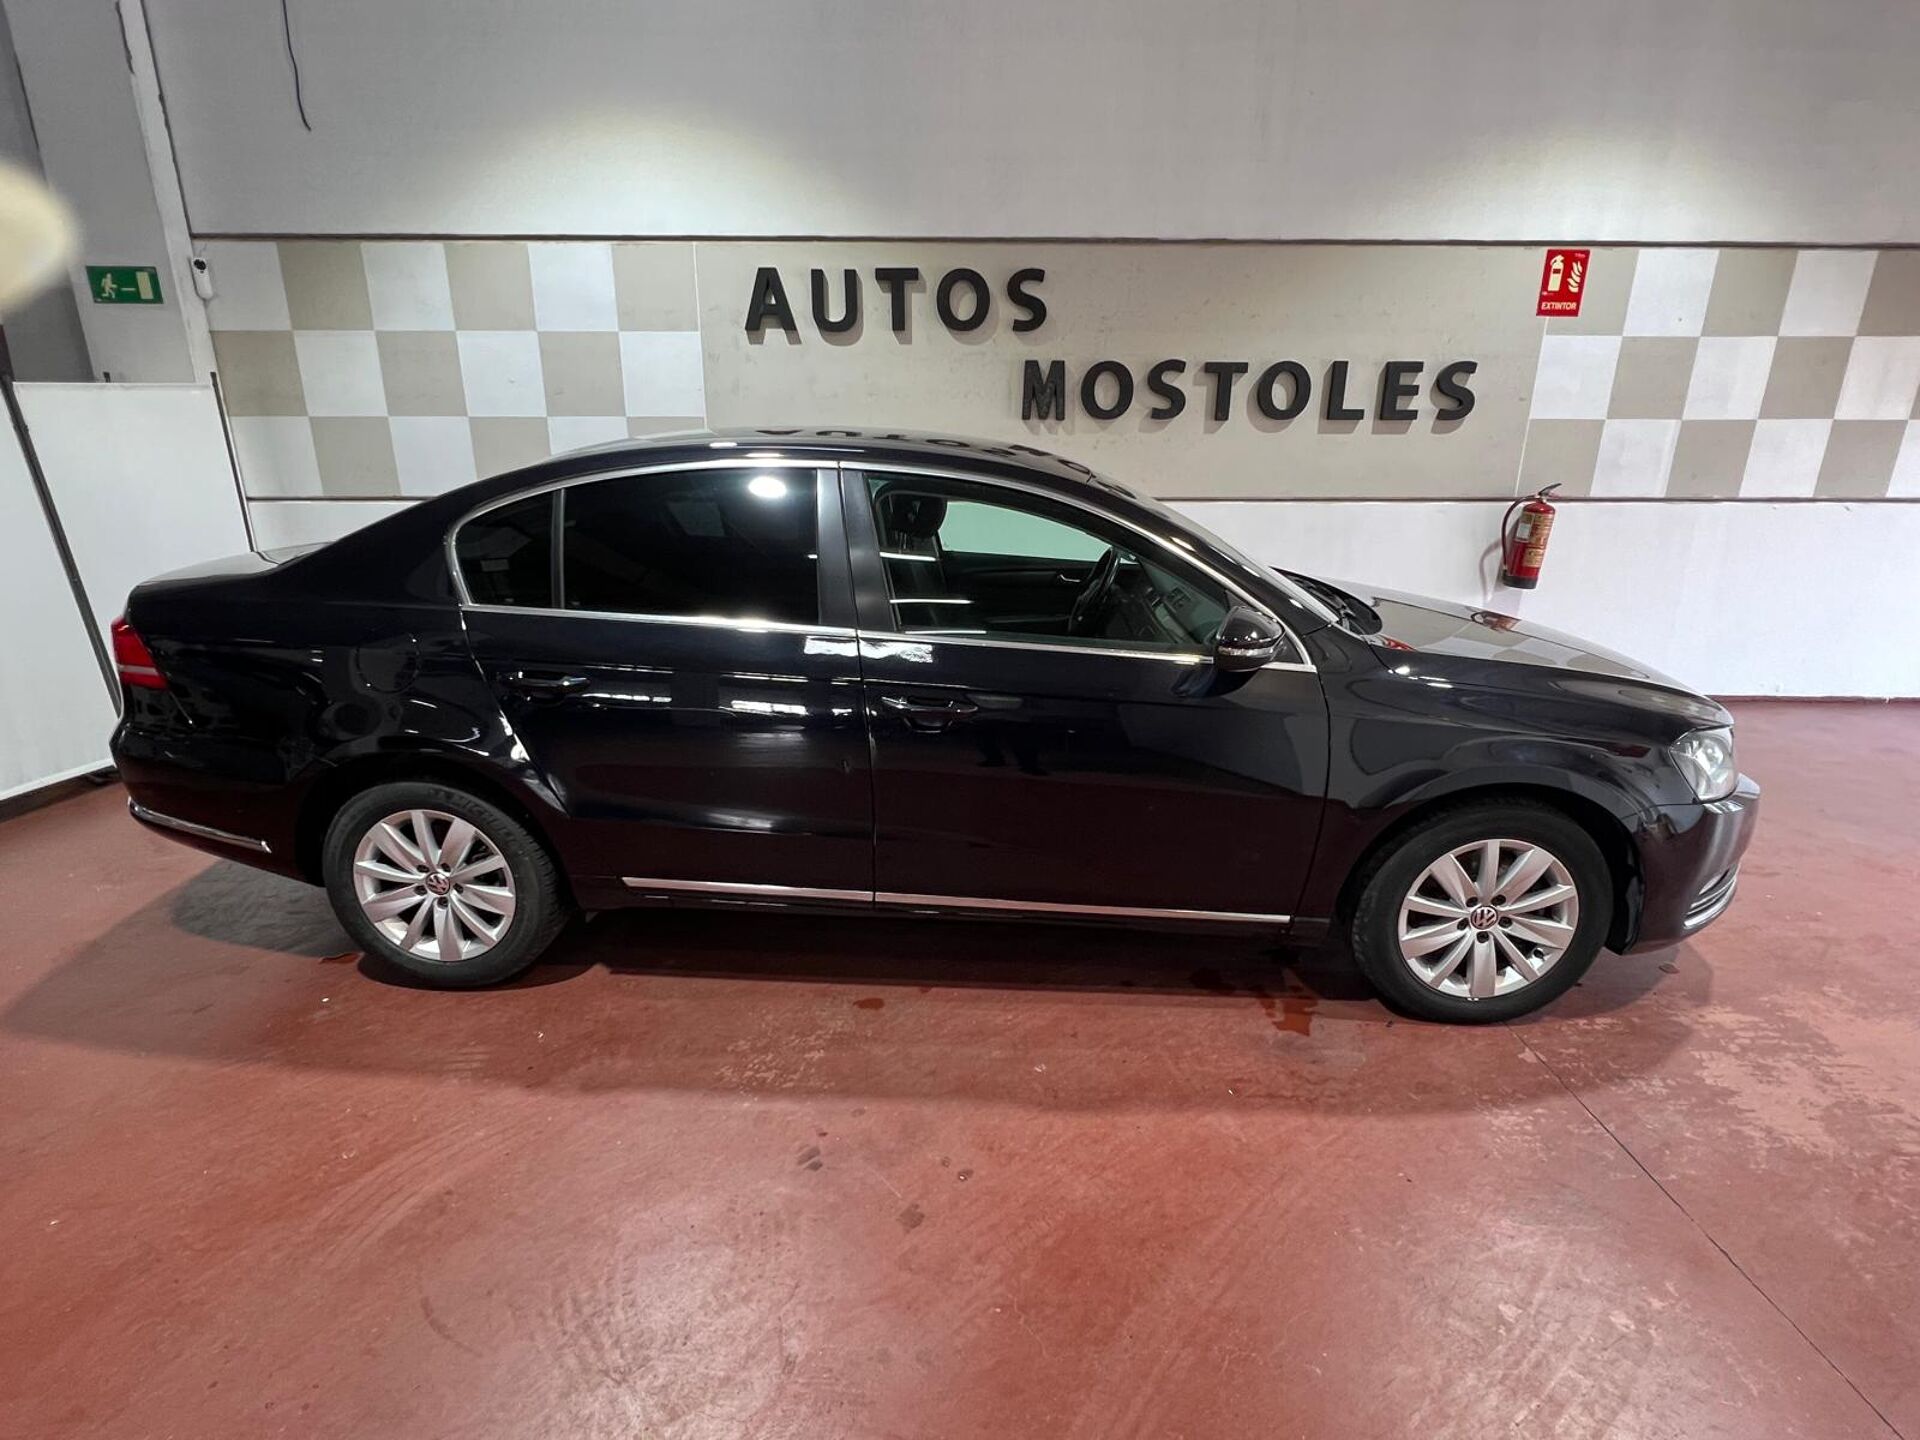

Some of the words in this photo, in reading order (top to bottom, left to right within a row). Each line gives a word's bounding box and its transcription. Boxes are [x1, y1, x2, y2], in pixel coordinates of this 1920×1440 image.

[745, 267, 1047, 332] AUTOS
[1541, 301, 1577, 311] EXTINTOR
[1022, 359, 1478, 421] MOSTOLES
